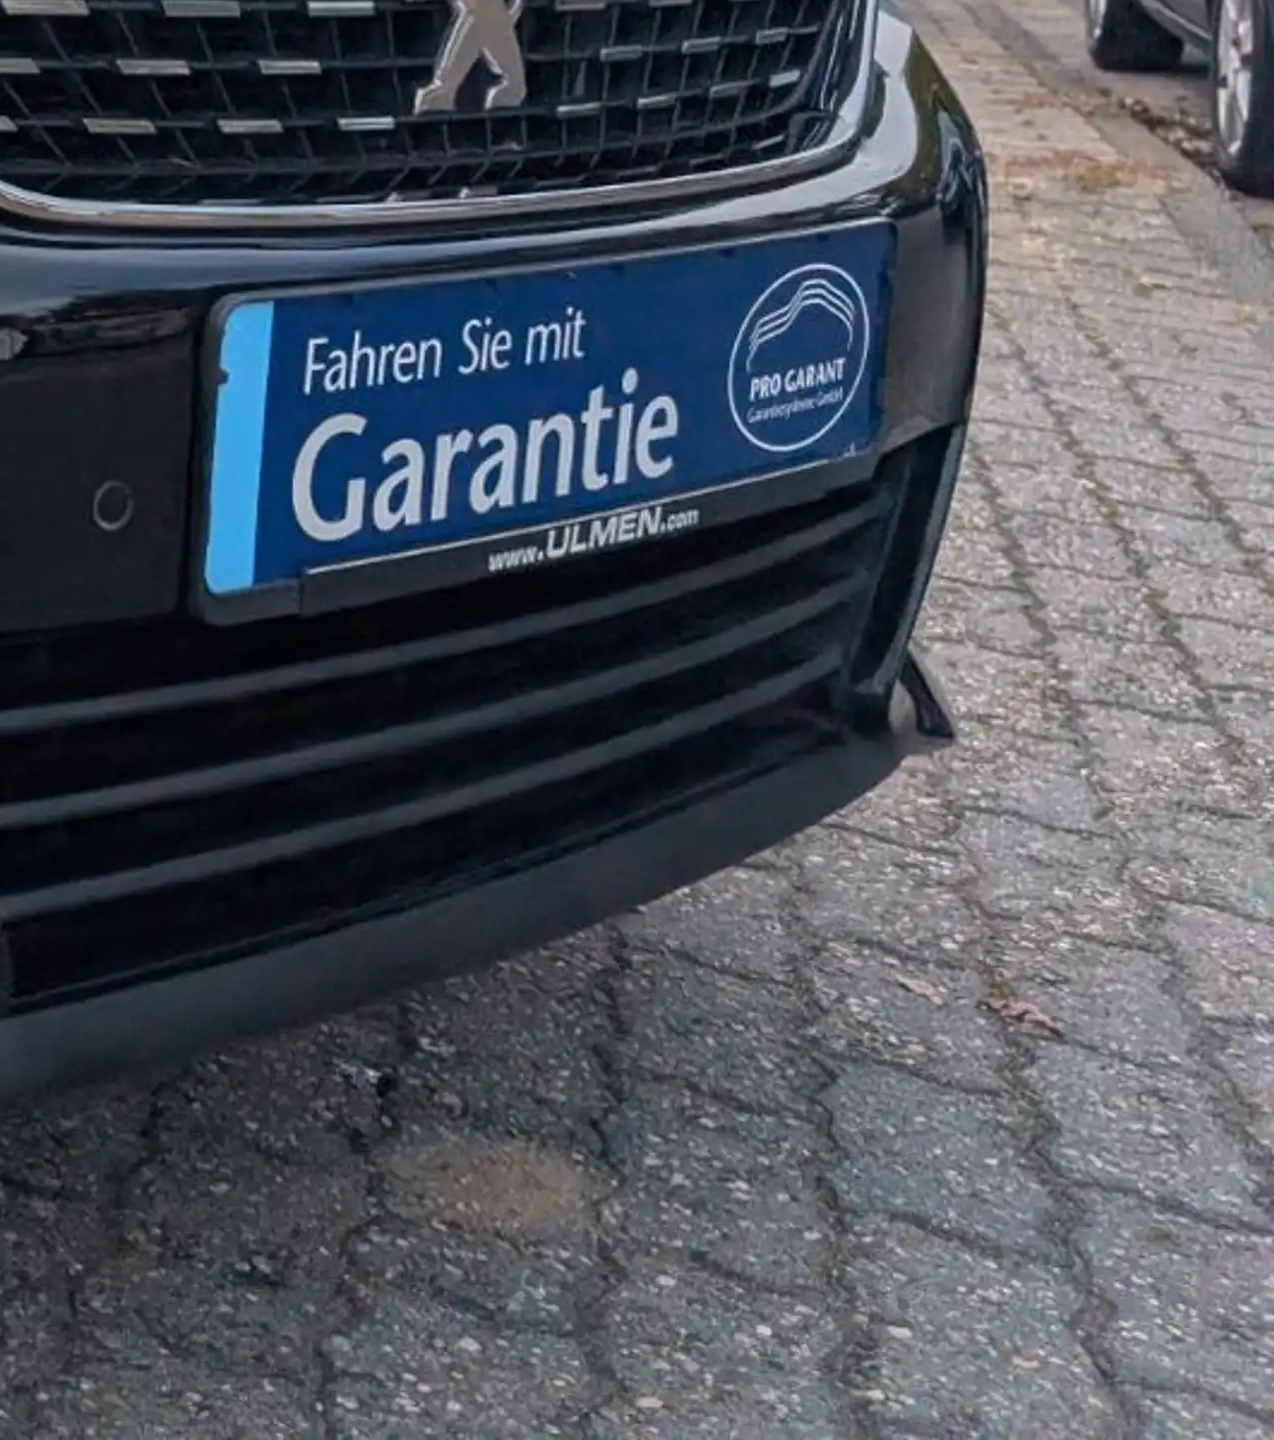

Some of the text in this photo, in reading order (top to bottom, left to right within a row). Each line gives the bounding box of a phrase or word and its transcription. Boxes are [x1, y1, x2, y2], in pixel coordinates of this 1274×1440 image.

[303, 306, 587, 395] Fahren Sie mit
[750, 356, 846, 401] PRO GARANT
[292, 367, 679, 541] Garantie
[488, 506, 700, 572] www.ULMEN.com
